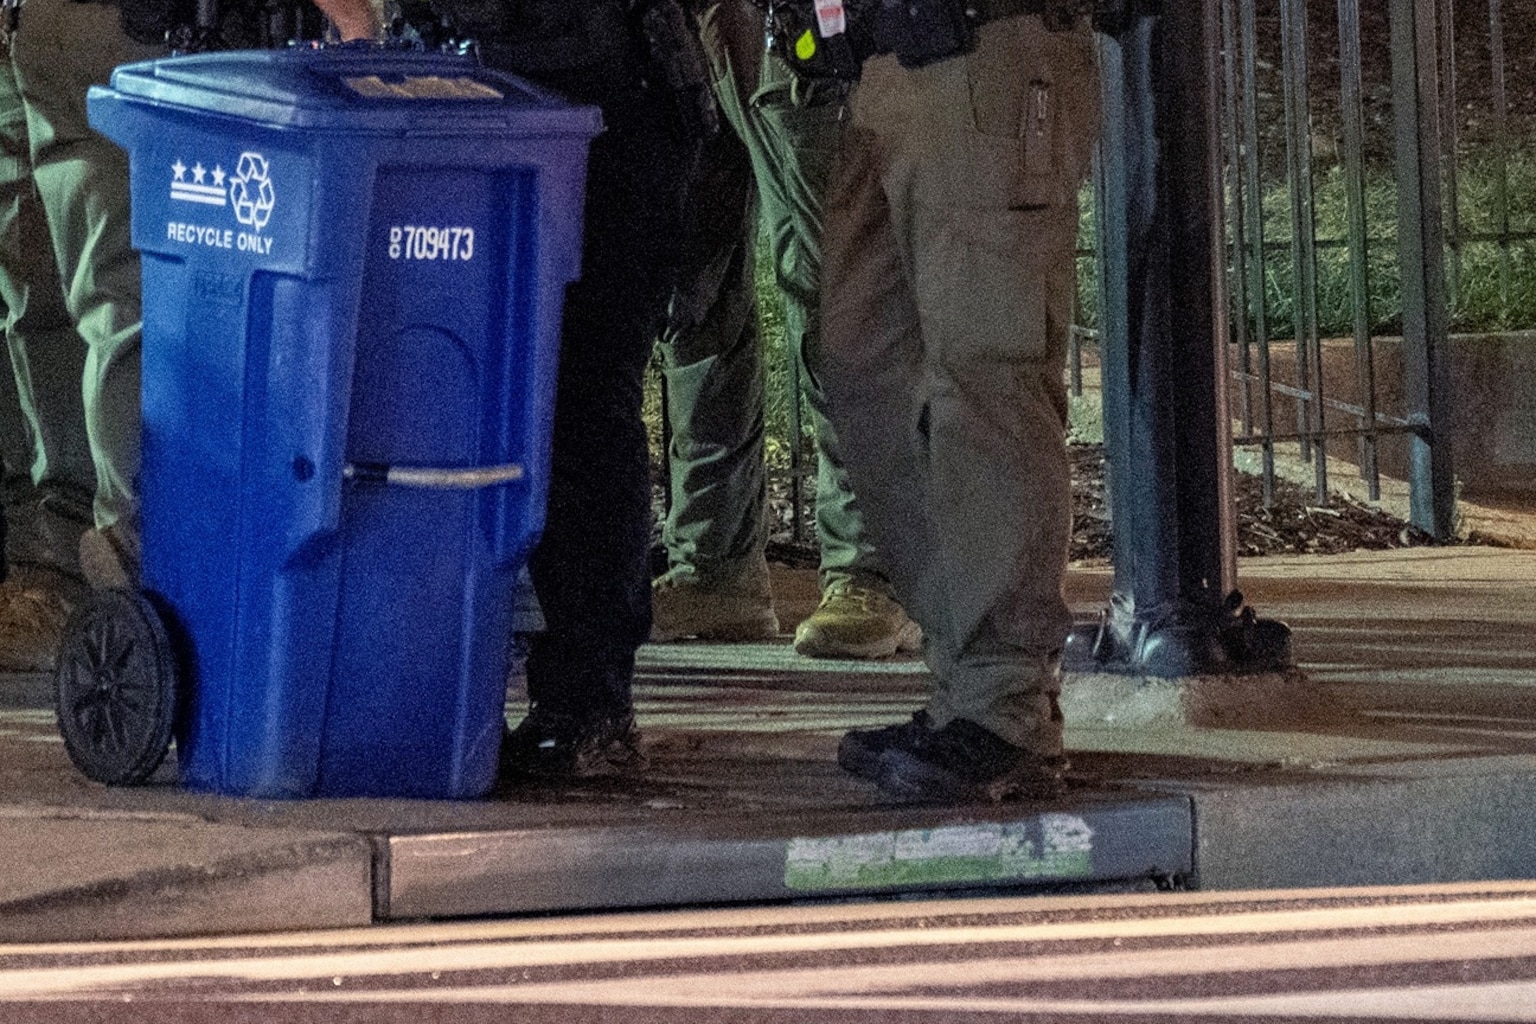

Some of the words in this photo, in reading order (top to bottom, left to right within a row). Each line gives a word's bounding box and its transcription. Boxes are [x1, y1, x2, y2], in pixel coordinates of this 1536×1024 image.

[167, 221, 233, 249] RECYCLE
[236, 232, 273, 255] ONLY
[404, 225, 474, 261] 709473
